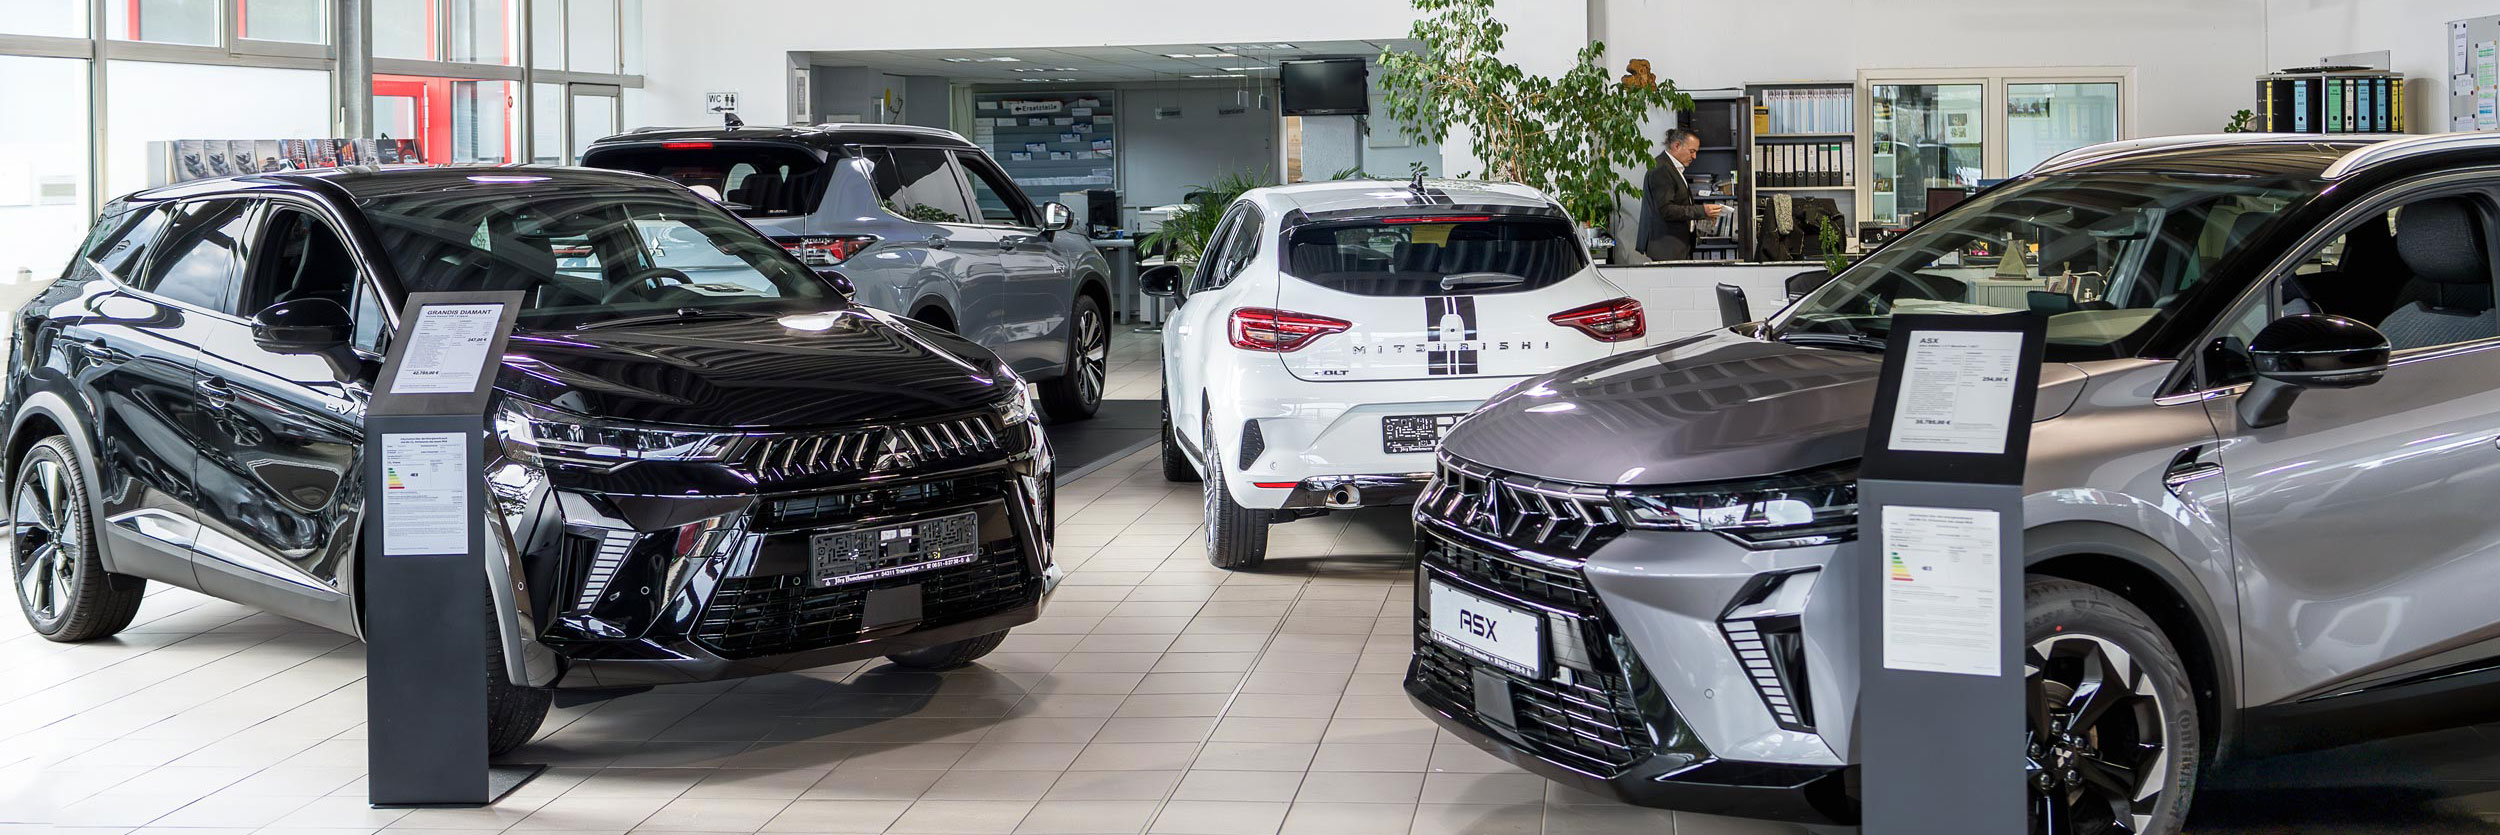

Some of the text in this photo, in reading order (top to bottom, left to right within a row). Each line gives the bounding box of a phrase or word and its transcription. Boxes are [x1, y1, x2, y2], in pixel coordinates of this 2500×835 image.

[708, 94, 722, 103] WC
[1022, 103, 1057, 111] Ersatzteile
[1460, 608, 1498, 642] ASX
